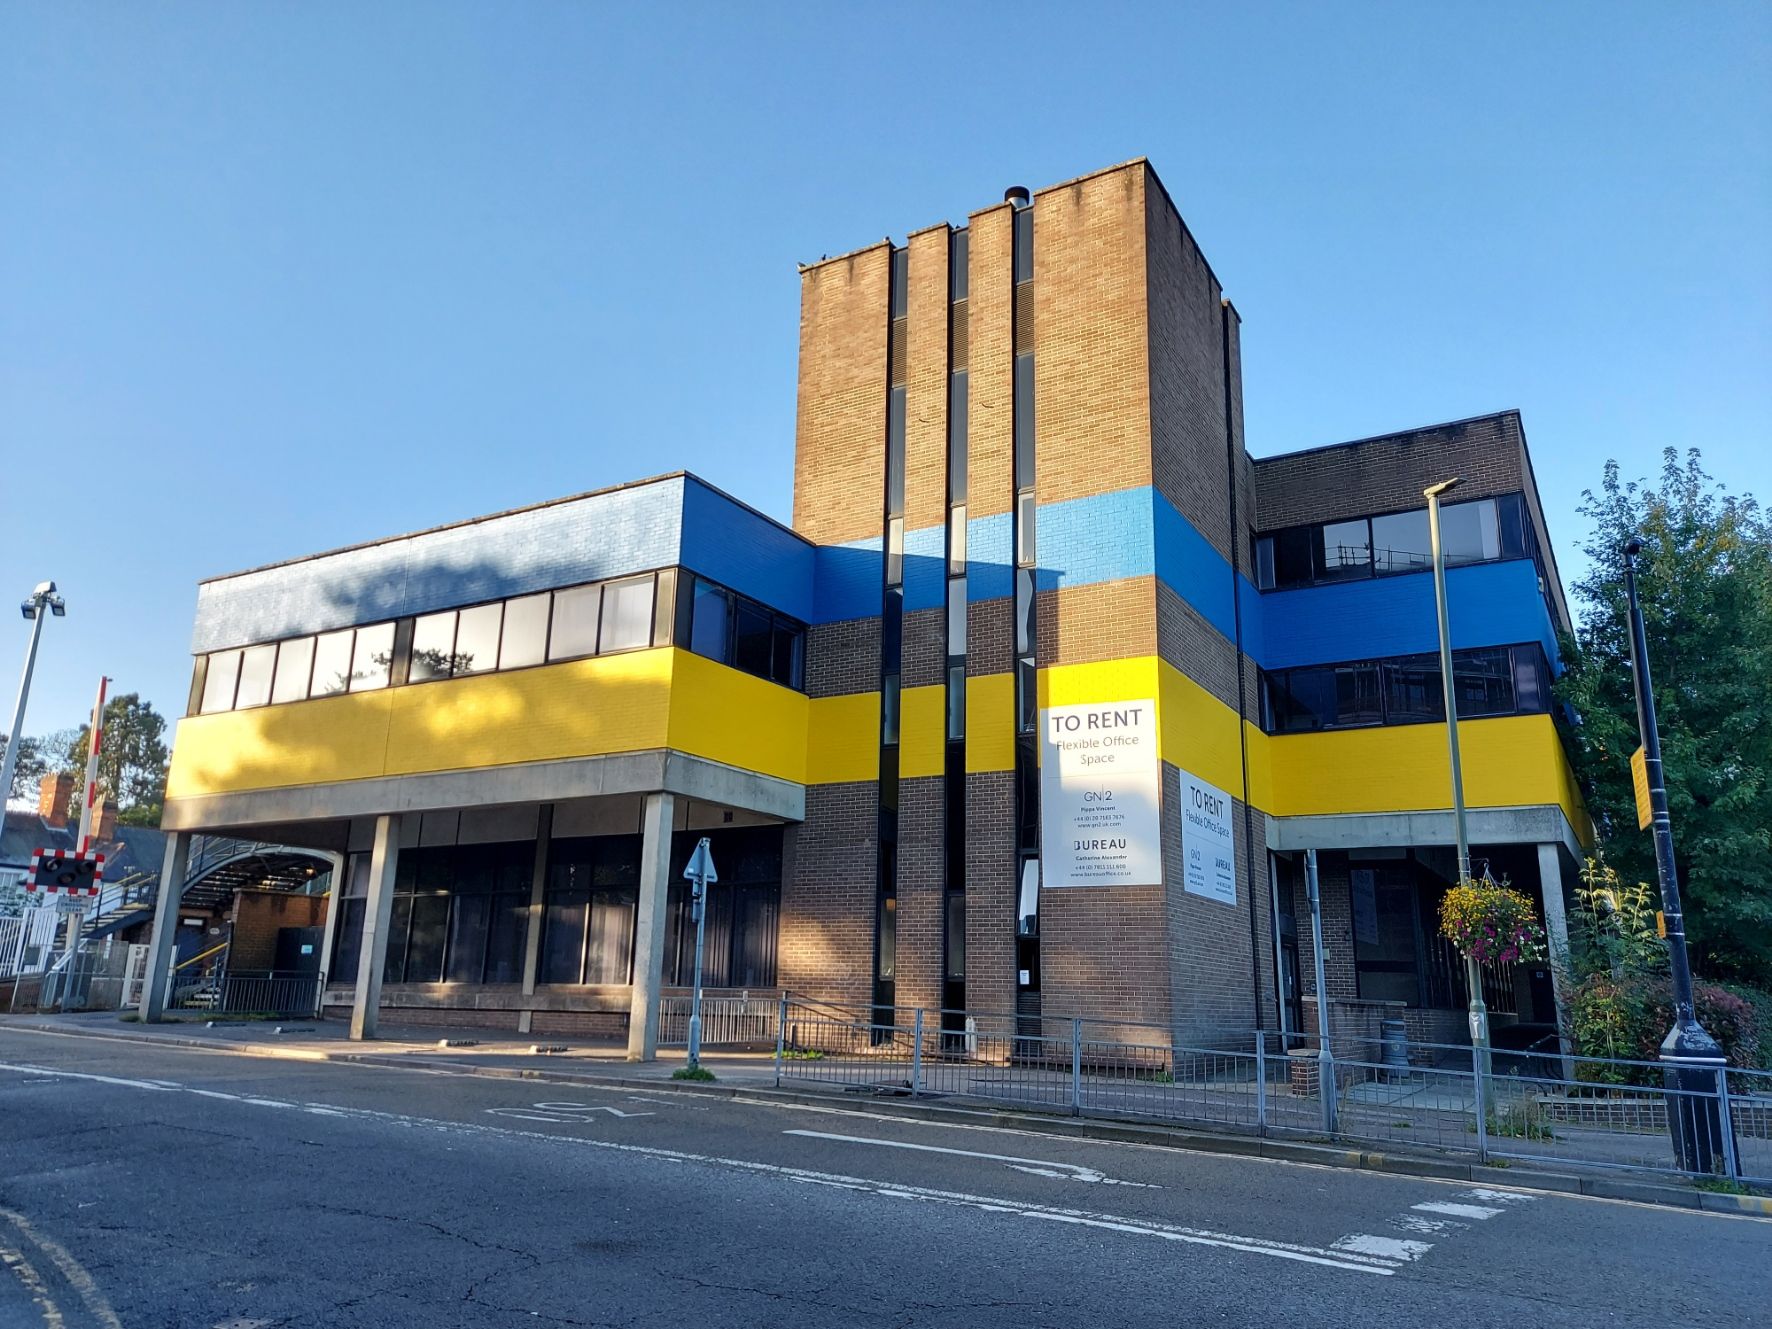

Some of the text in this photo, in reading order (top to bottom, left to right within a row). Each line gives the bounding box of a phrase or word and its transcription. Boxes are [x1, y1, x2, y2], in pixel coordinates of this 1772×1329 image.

[1052, 709, 1143, 733] TO RENT
[1056, 734, 1140, 751] Flexible Office
[1080, 753, 1115, 766] Space
[1190, 786, 1224, 819] TO RENT
[1216, 821, 1230, 839] Space
[1073, 838, 1126, 851] BUREAU
